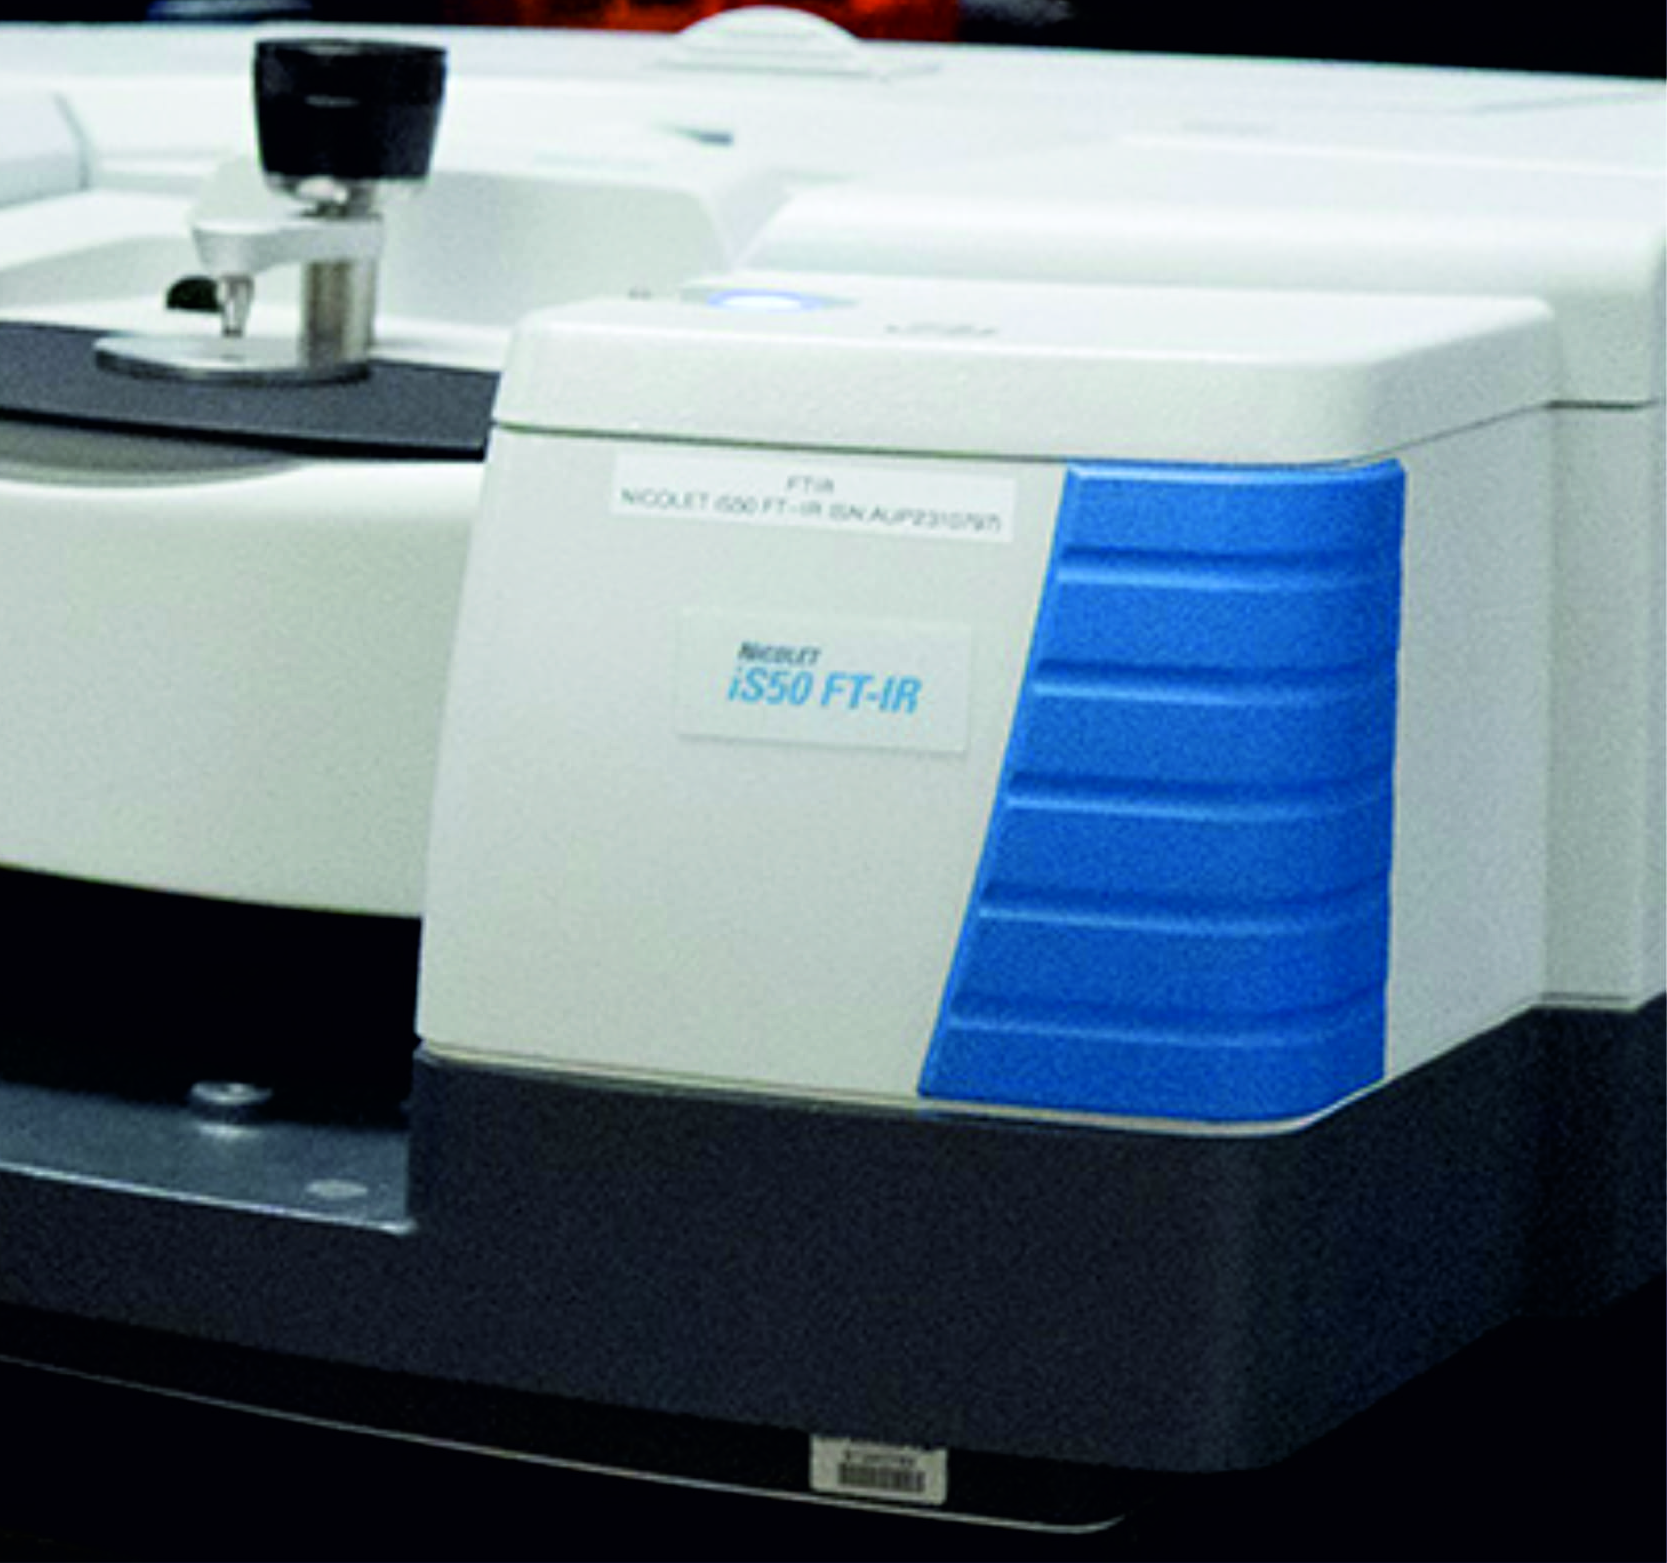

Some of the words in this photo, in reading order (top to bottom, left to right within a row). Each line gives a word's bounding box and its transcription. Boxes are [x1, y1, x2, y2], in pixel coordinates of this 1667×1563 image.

[621, 487, 709, 511] NICOLET
[728, 666, 813, 705] iS50
[821, 671, 922, 714] FT-IR
